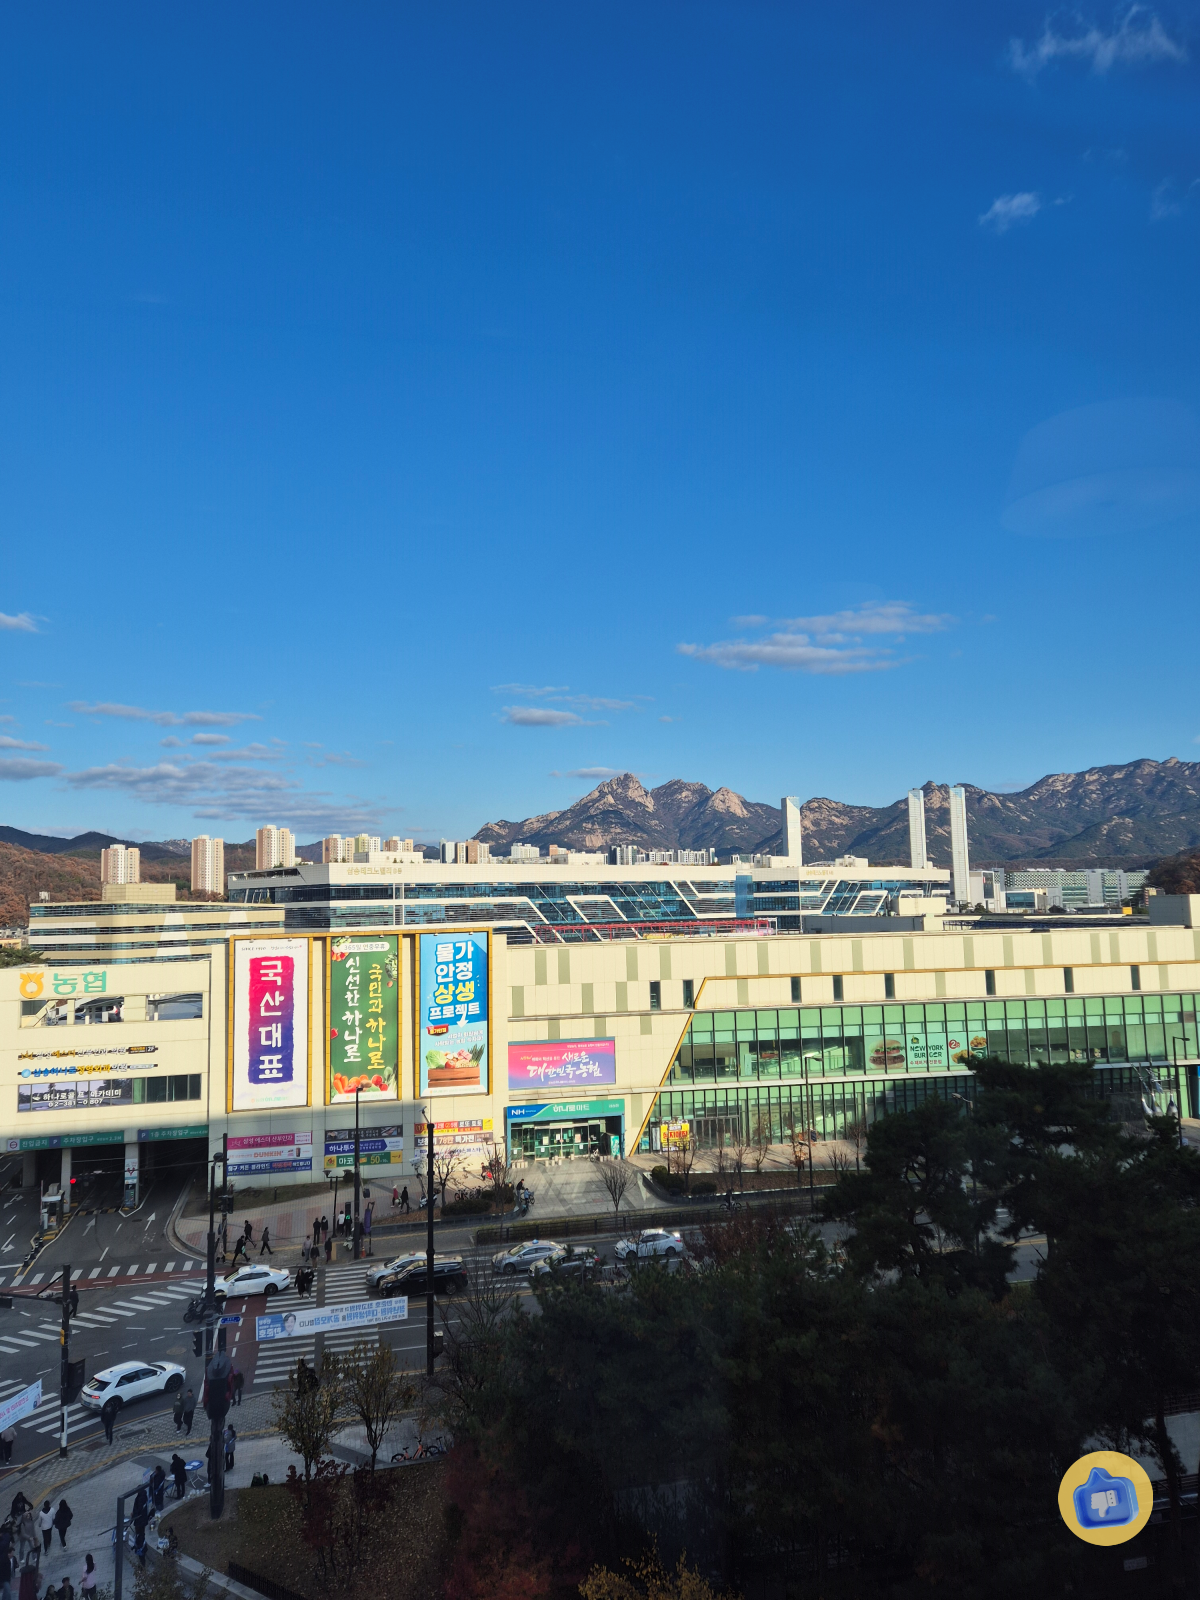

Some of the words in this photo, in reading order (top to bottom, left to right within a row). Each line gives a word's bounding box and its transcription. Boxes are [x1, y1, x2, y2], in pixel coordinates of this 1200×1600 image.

[363, 943, 385, 951] 연중무휴
[436, 940, 474, 963] 물가
[52, 970, 107, 995] 농협
[344, 956, 360, 1007] 신선한
[435, 960, 473, 983] 안정
[368, 963, 383, 1014] 국민과
[434, 980, 475, 1005] 상생
[258, 960, 285, 1079] 국산대표
[429, 1002, 480, 1020] 프로젝트
[342, 1010, 362, 1062] 하나로
[366, 1017, 386, 1070] 하나로
[562, 1050, 590, 1063] 새로운
[526, 1062, 576, 1082] 대한민국
[576, 1060, 603, 1078] 농협
[511, 1108, 525, 1116] NH
[552, 1103, 590, 1113] 하나로마트
[22, 1139, 48, 1148] 진입금지
[63, 1135, 94, 1144] 주차장입구
[160, 1129, 189, 1138] 주차장입구
